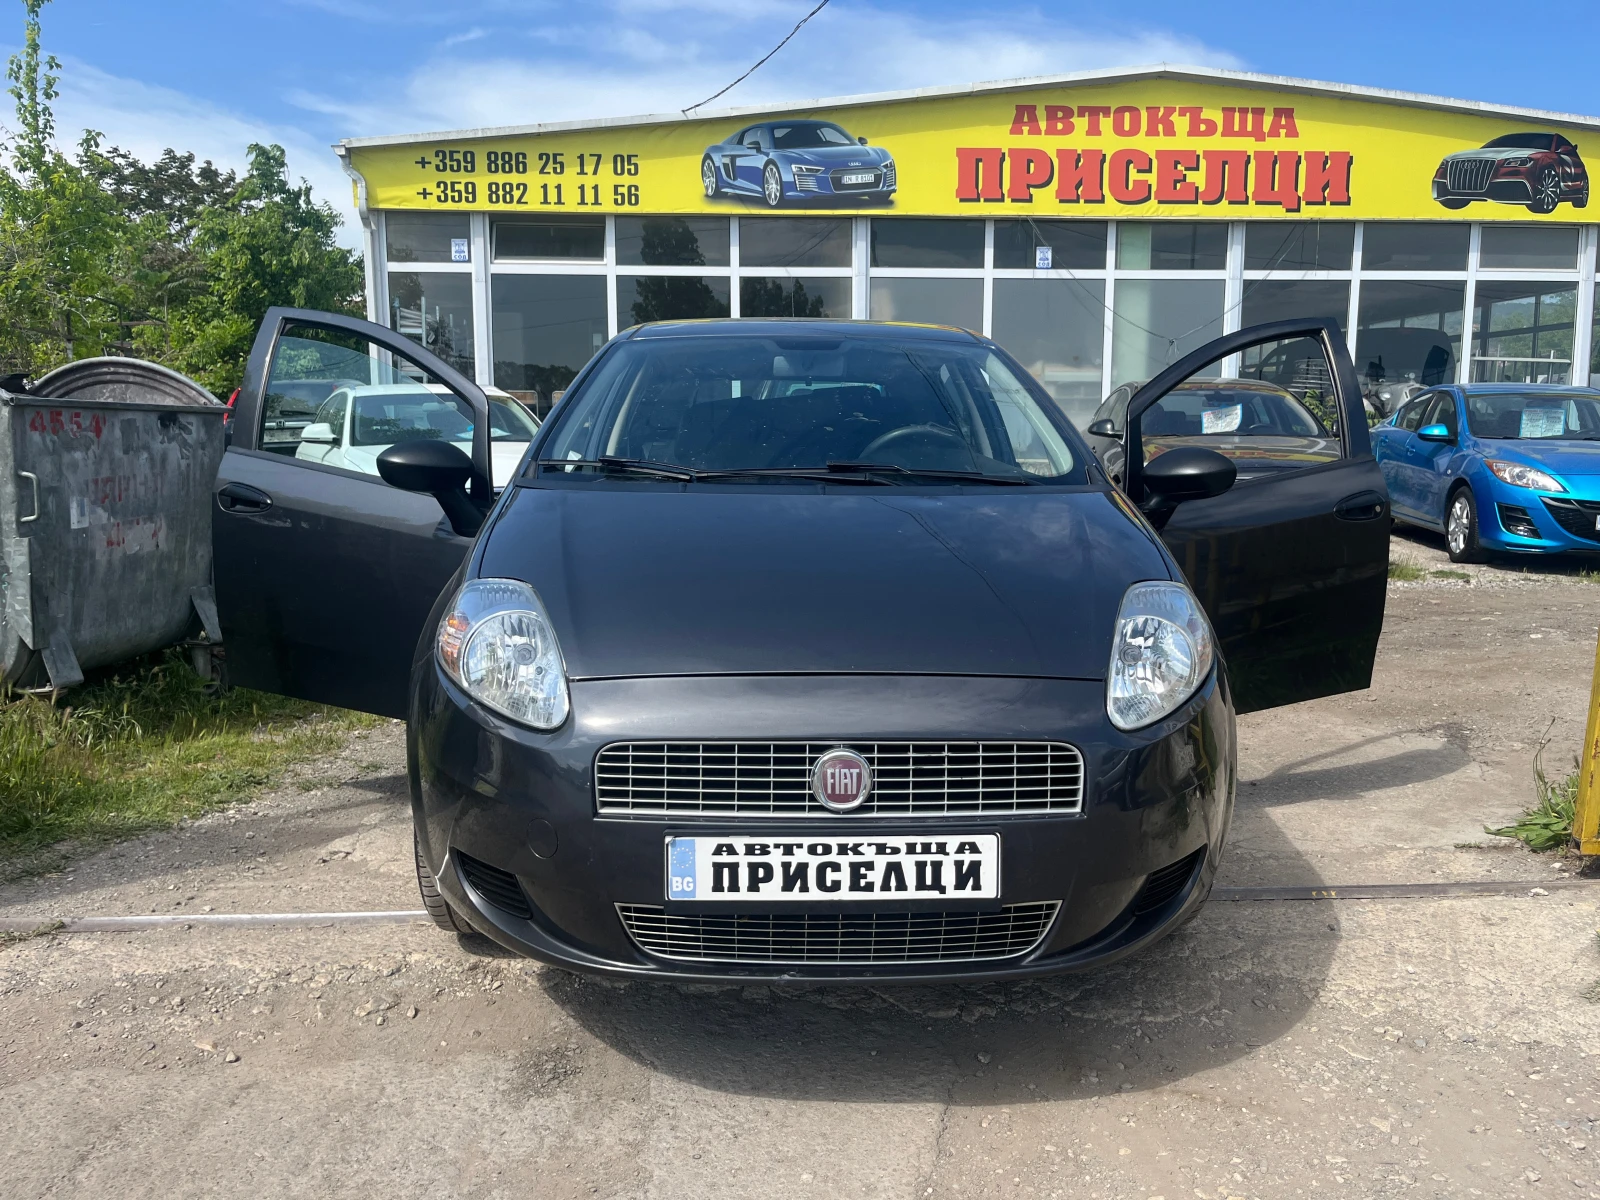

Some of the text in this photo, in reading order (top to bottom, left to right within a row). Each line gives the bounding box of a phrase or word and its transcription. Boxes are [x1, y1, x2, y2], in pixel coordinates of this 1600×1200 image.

[1009, 105, 1299, 142] АВТОКЪЩА
[415, 150, 639, 176] +359 886 25 17 05
[956, 147, 1353, 212] ПРИСЕЛЦИ
[416, 180, 640, 206] +359 882 11 11 56
[827, 768, 860, 795] FIAT
[711, 841, 983, 857] АВТОКЪЩА
[672, 876, 694, 892] BG
[711, 860, 982, 894] ПРИСЕЛЦИ
